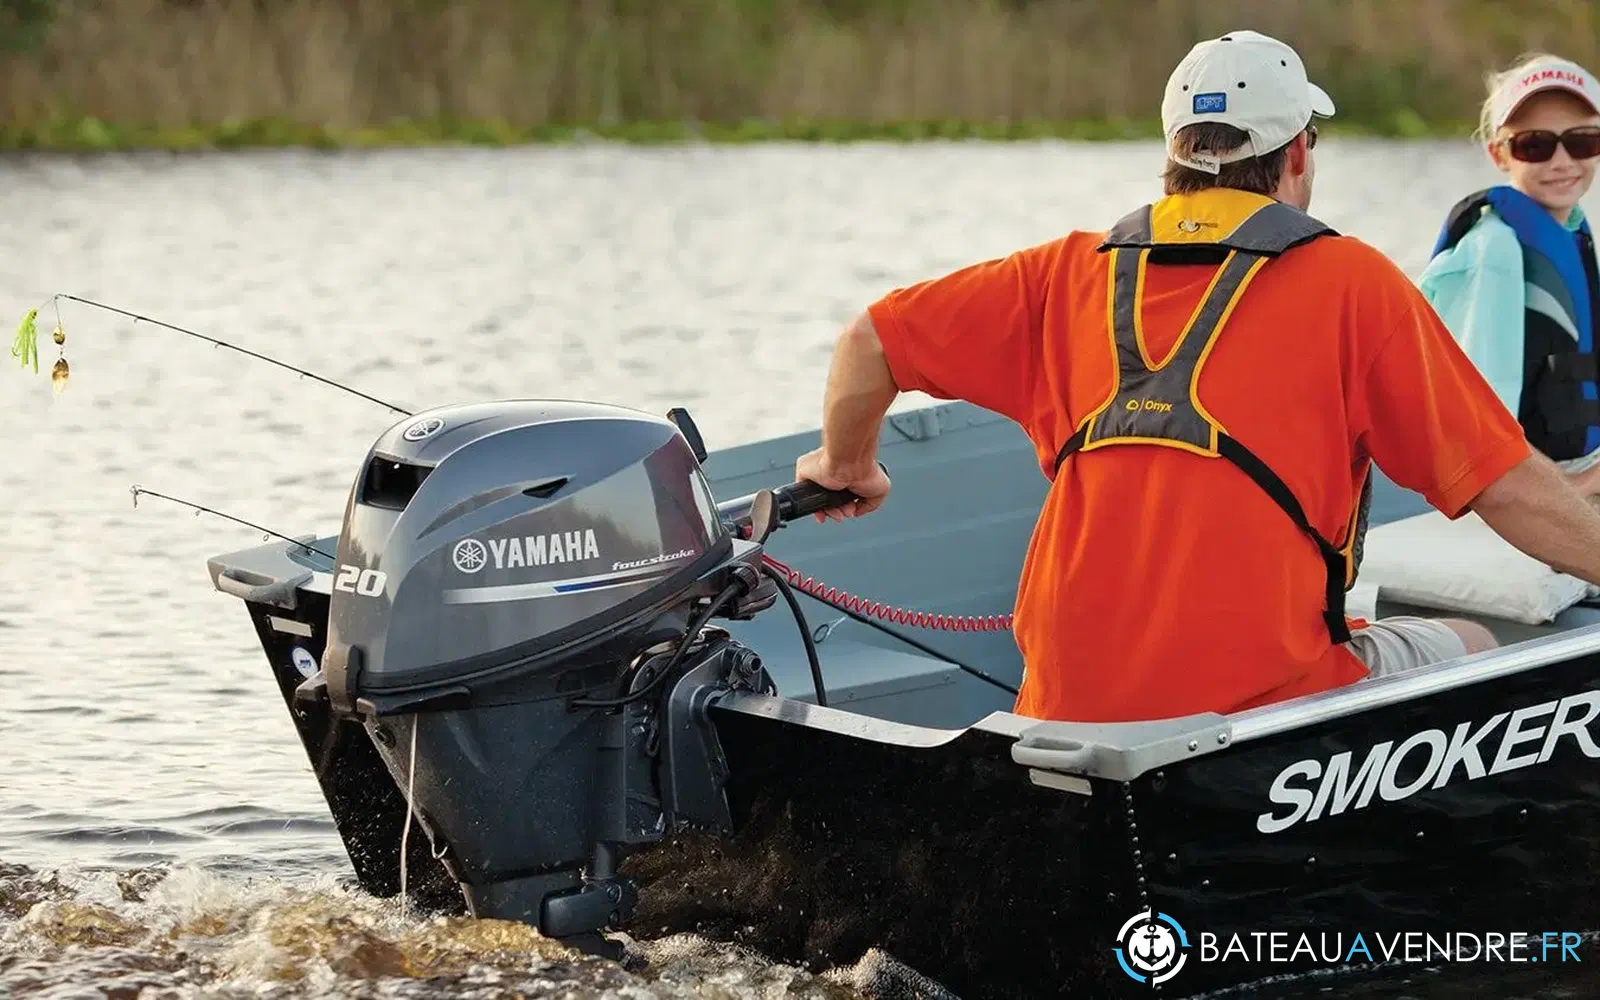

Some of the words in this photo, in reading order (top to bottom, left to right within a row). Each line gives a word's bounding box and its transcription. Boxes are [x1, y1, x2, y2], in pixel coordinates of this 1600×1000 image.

[1522, 71, 1584, 87] YAMAHA
[1145, 400, 1173, 413] Onyx
[488, 529, 601, 569] YAMAHA
[335, 564, 388, 598] 20
[1256, 690, 1600, 834] SMOKER
